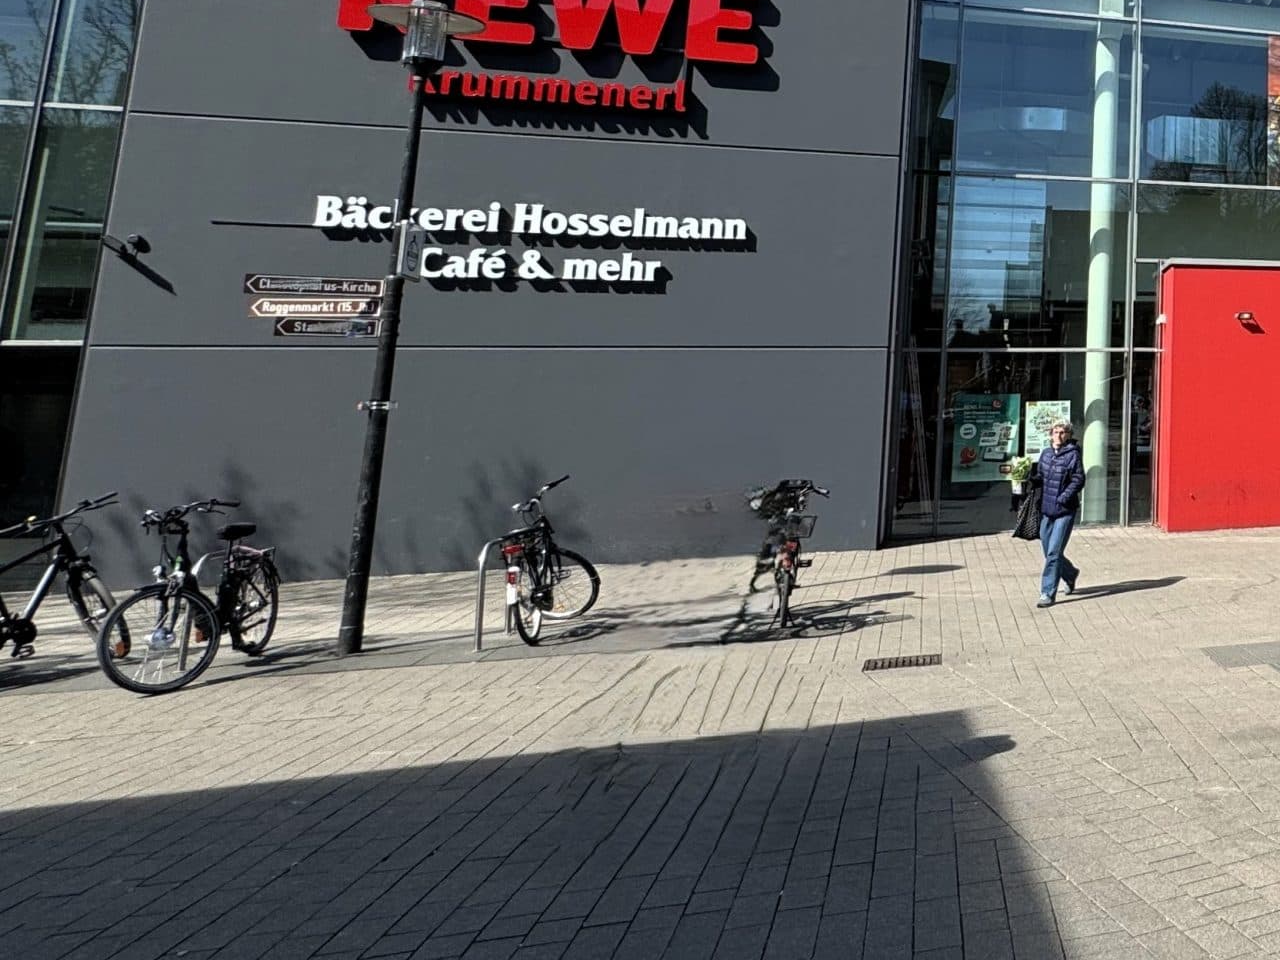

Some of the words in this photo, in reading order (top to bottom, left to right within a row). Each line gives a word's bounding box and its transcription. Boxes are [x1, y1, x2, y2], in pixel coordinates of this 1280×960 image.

[513, 203, 747, 240] Hosselmann
[419, 246, 506, 279] Café
[518, 249, 556, 280] &
[562, 252, 661, 282] mehr
[262, 301, 334, 316] Roggenmarkt
